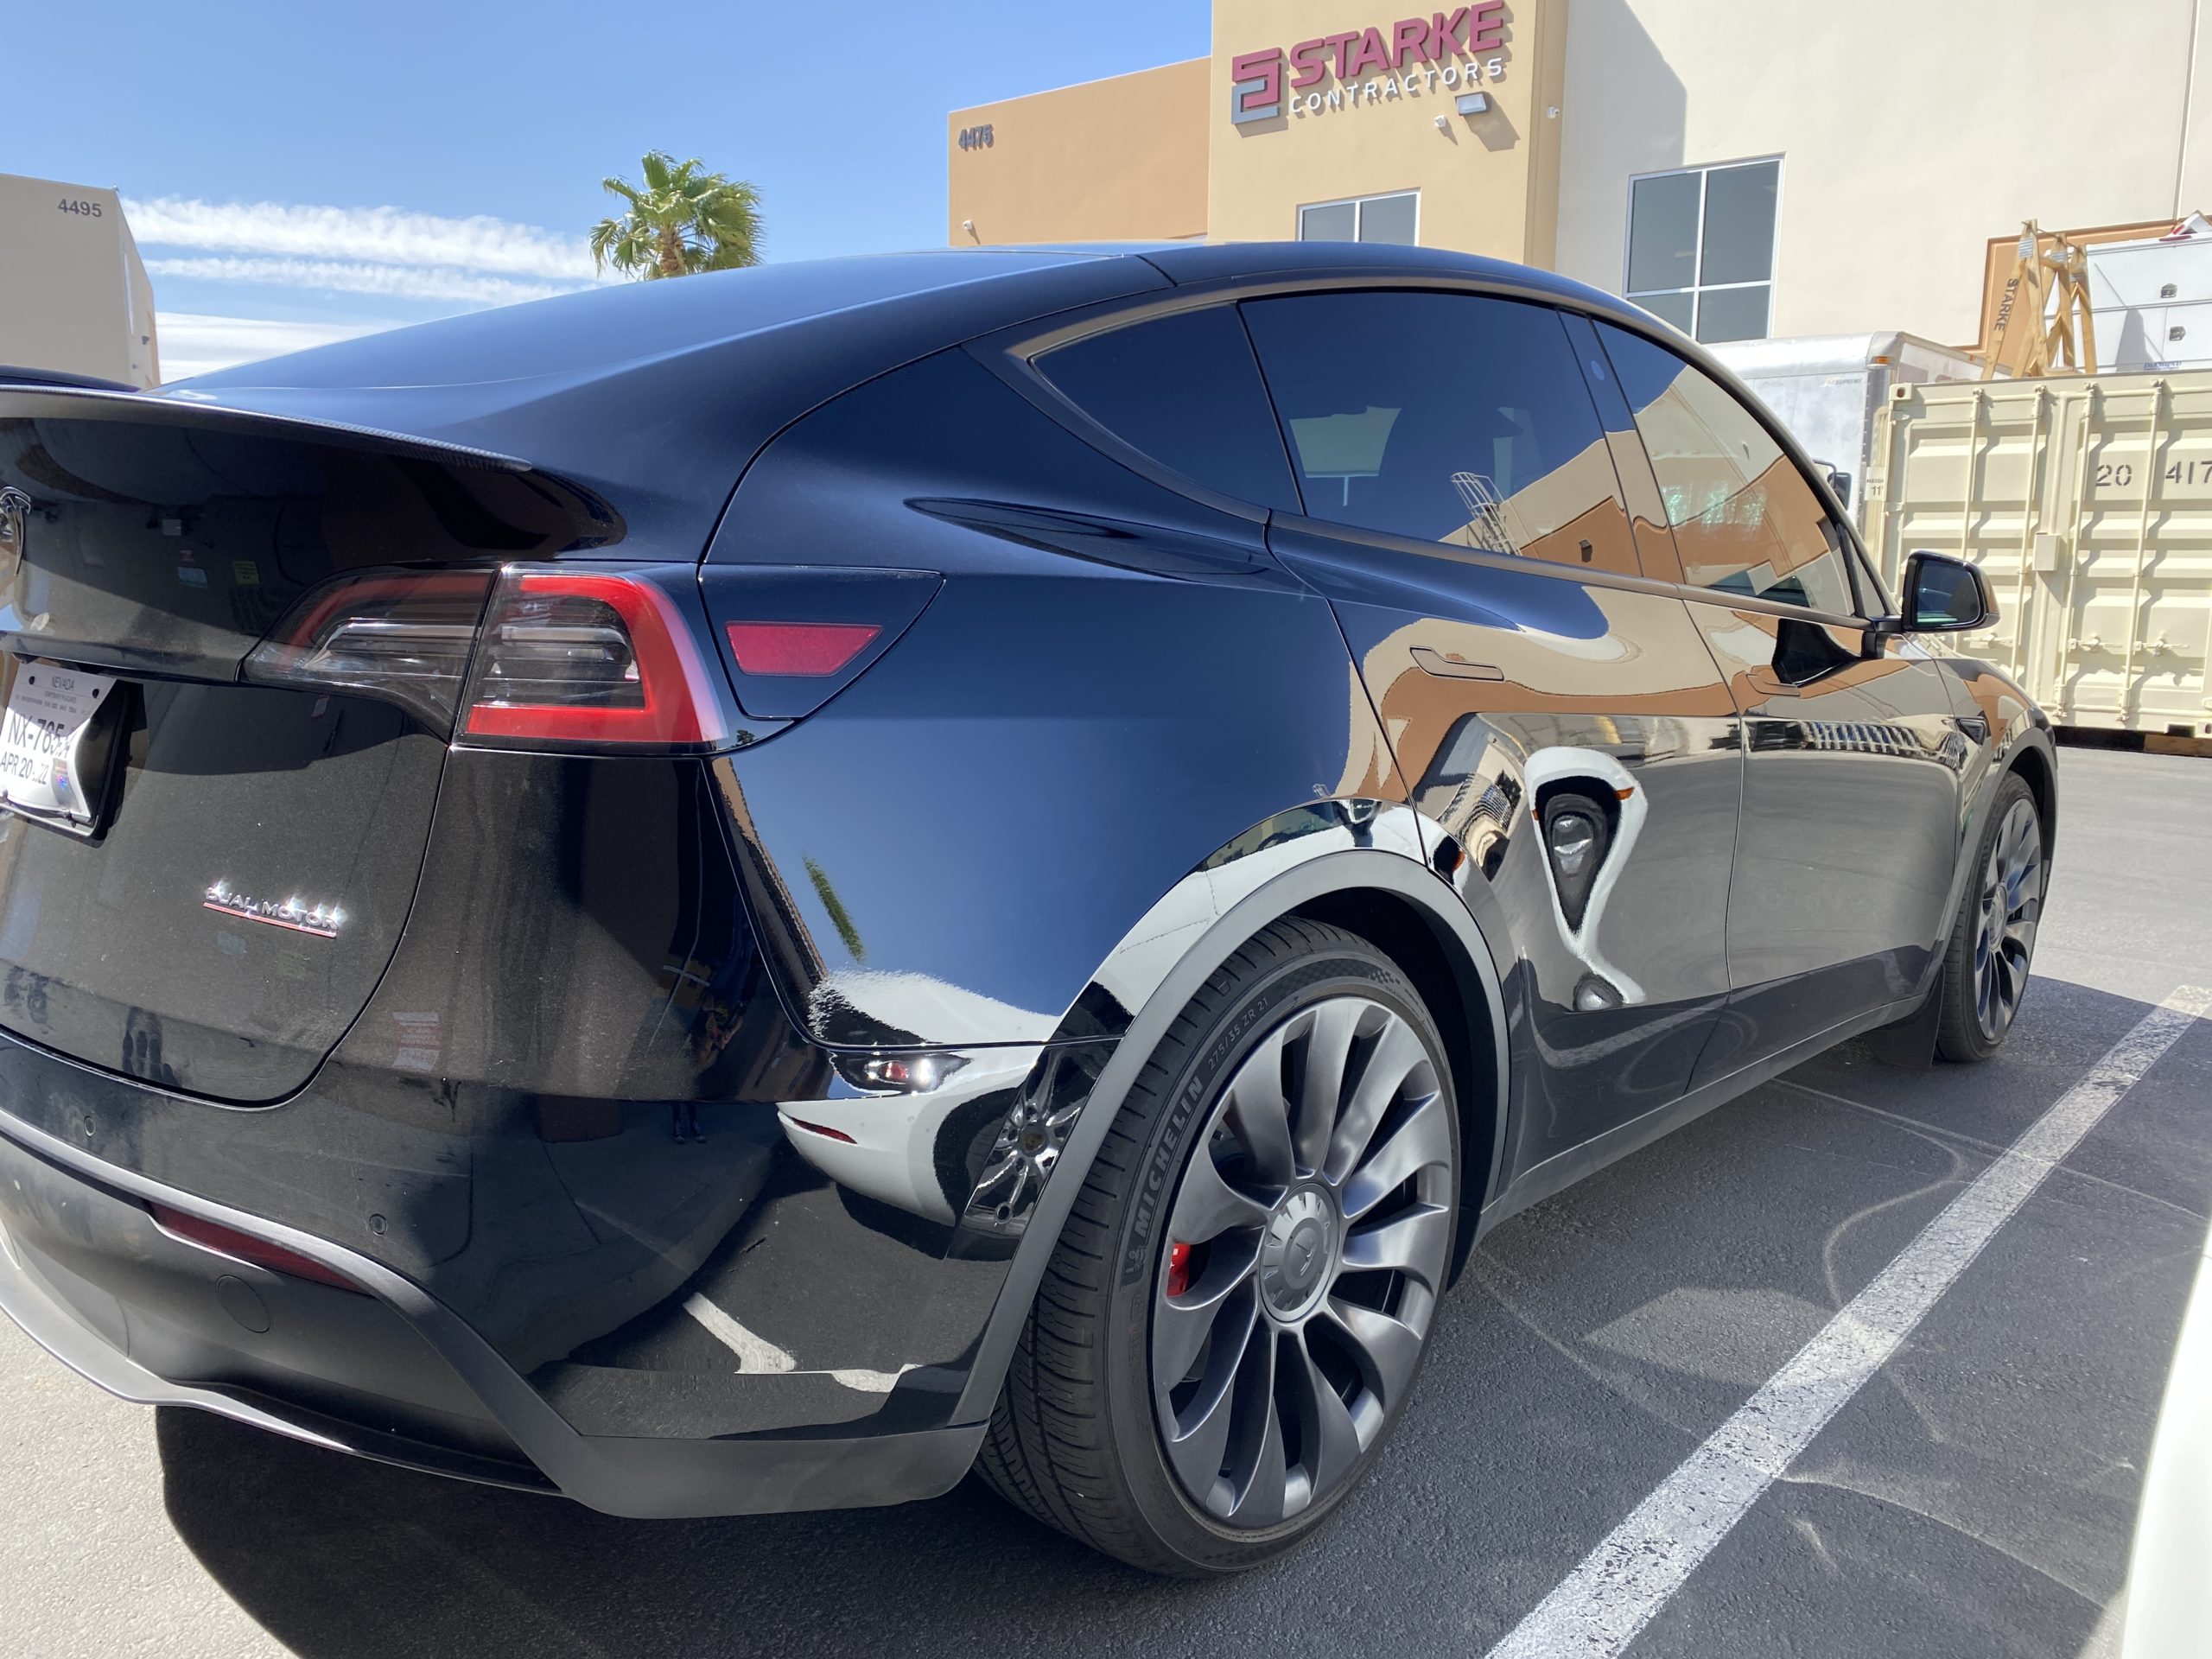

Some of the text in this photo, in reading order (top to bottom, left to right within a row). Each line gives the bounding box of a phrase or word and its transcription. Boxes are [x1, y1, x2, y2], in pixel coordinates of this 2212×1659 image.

[1290, 0, 1504, 87] STARKE
[1291, 57, 1503, 113] CONTRACTORS
[959, 124, 994, 151] 4475
[58, 199, 102, 217] 4495
[1995, 278, 2019, 331] STARKE
[2095, 464, 2133, 486] 20
[52, 676, 75, 691] NEVADA
[0, 751, 19, 775] APR
[261, 900, 340, 930] MOTOR
[1208, 997, 1268, 1071] 275/35 ZR 21
[1135, 1077, 1204, 1238] MICHELIN
